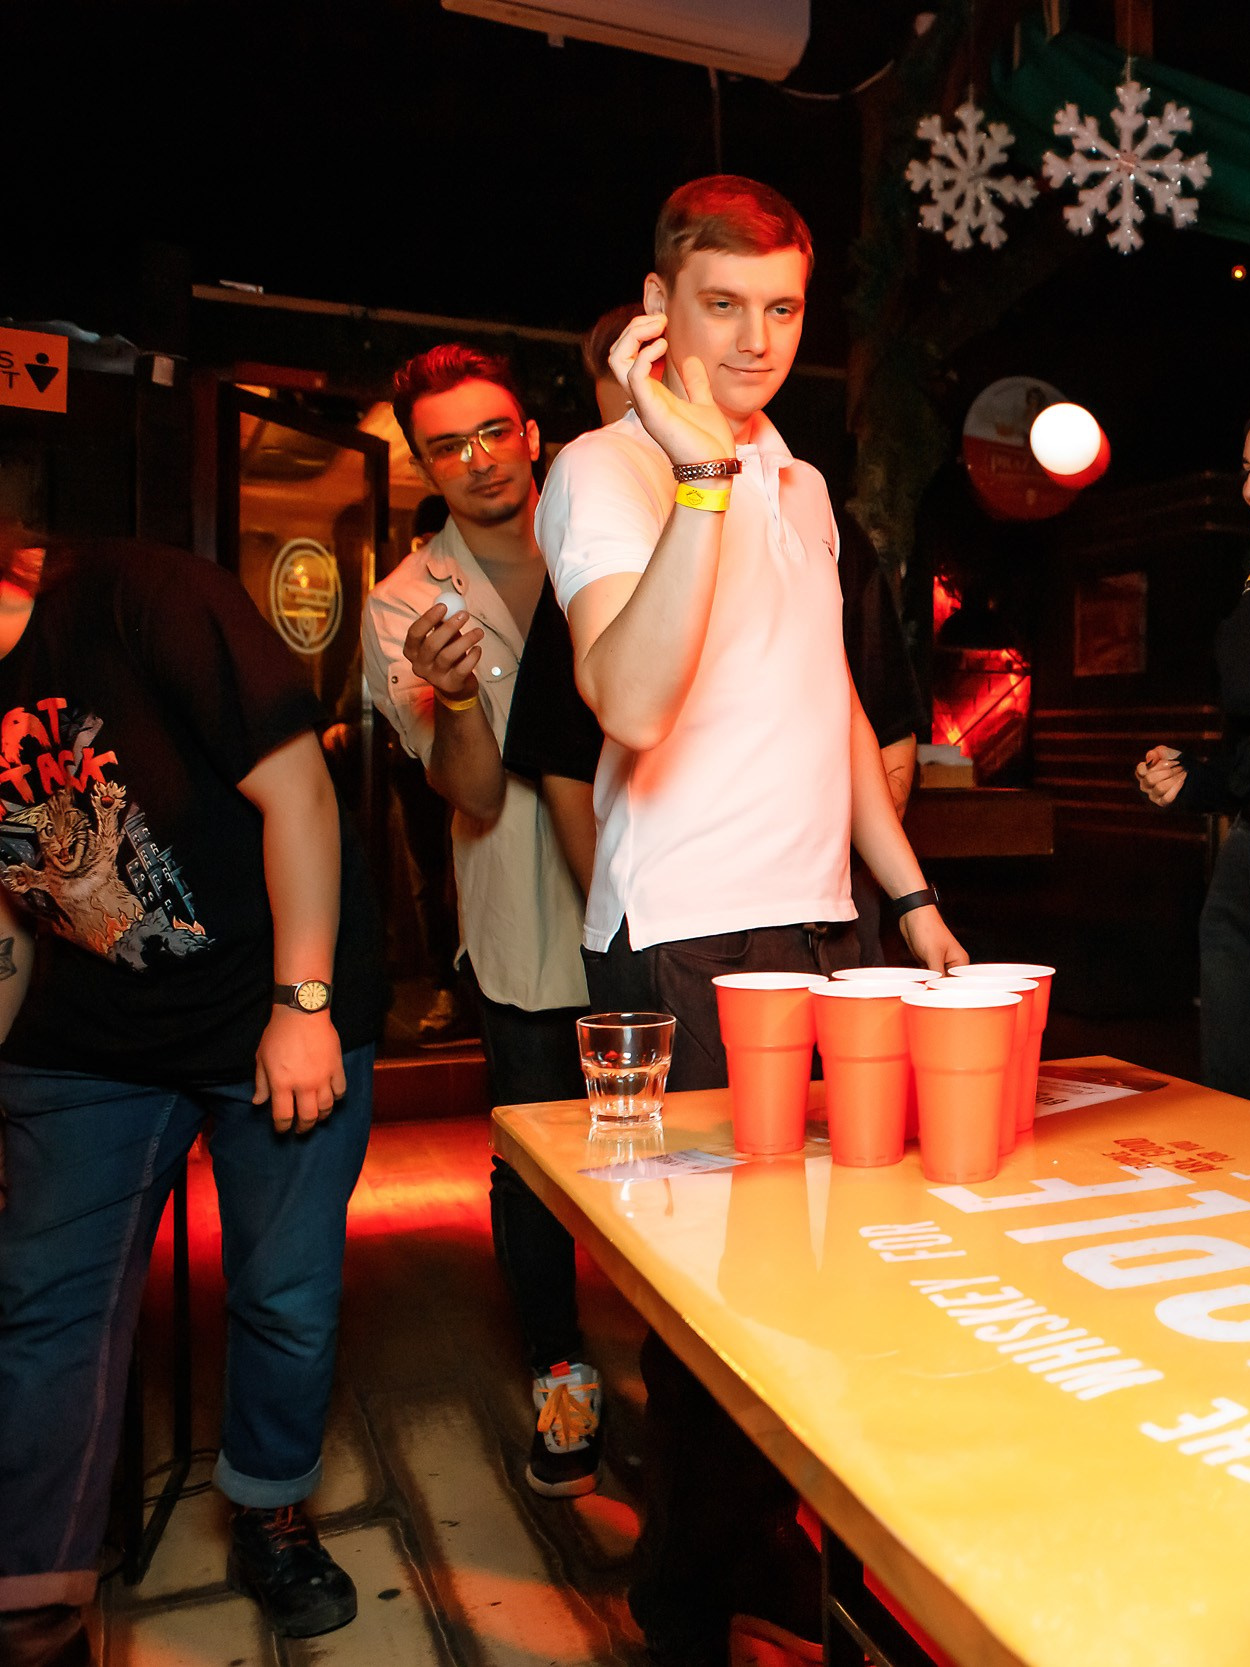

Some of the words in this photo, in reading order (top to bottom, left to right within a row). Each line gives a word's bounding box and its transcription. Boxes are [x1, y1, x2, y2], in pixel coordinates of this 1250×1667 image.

[0, 746, 119, 821] TACK
[1112, 1137, 1176, 1157] GOOD
[1161, 1157, 1223, 1173] ARE
[858, 1220, 967, 1263] FOR
[908, 1274, 1165, 1401] WHISKEY
